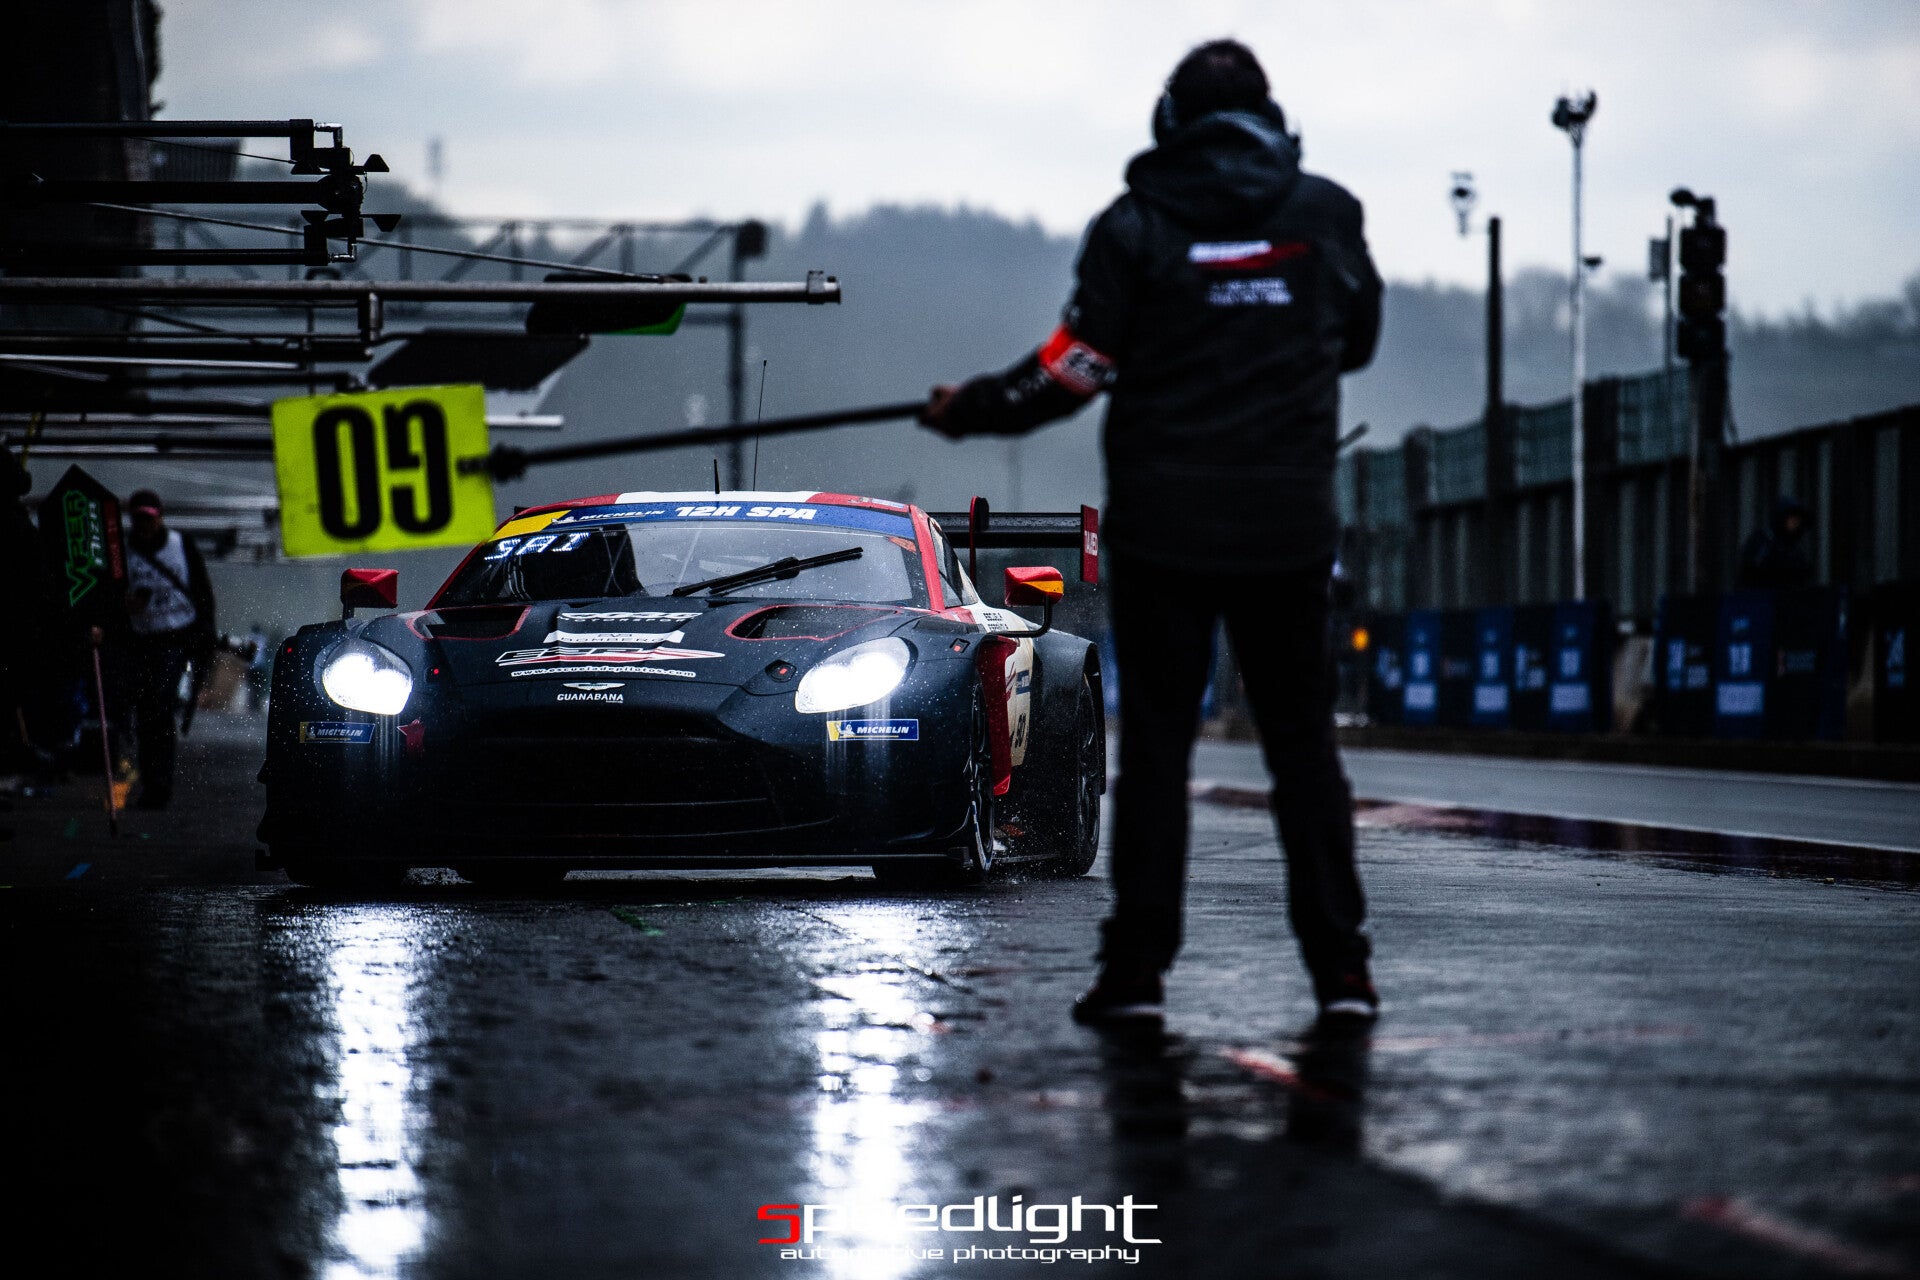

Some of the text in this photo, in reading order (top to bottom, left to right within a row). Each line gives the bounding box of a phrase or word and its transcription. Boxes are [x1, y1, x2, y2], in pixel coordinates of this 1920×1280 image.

[580, 510, 666, 520] MICHELIN
[675, 506, 818, 520] 12H SPA
[556, 693, 624, 702] GUANABANA
[856, 725, 910, 735] MICHELIN
